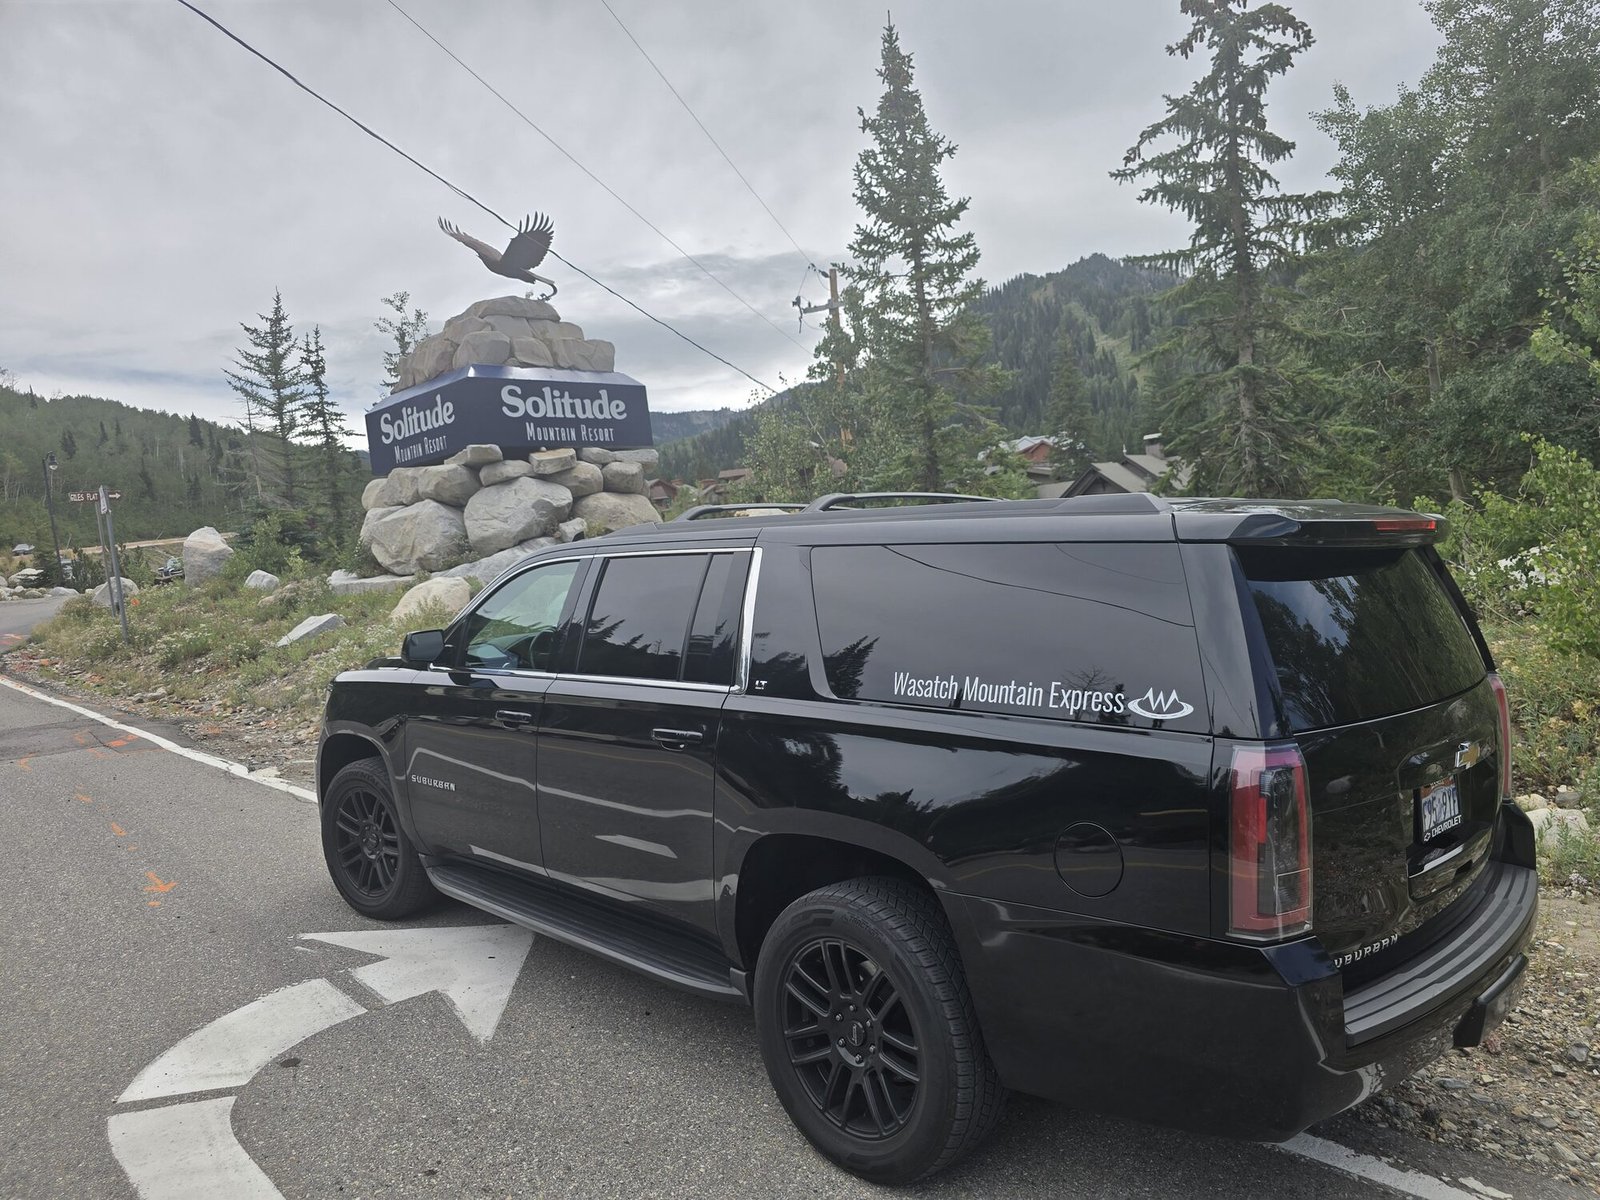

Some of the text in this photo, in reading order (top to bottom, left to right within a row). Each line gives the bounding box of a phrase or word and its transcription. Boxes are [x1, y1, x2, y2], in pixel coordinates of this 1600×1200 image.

[500, 384, 628, 420] Solitude
[379, 394, 456, 445] Solitude
[526, 422, 615, 443] MOUNTAIN RESORT
[394, 435, 447, 464] MOUNTAIN RESORT
[754, 679, 768, 690] LT
[893, 671, 1126, 715] Wasatch Mountain Express
[410, 774, 457, 792] SUBURBAN
[1431, 815, 1462, 838] CHEVROLET
[1333, 933, 1399, 969] UBURBAN
